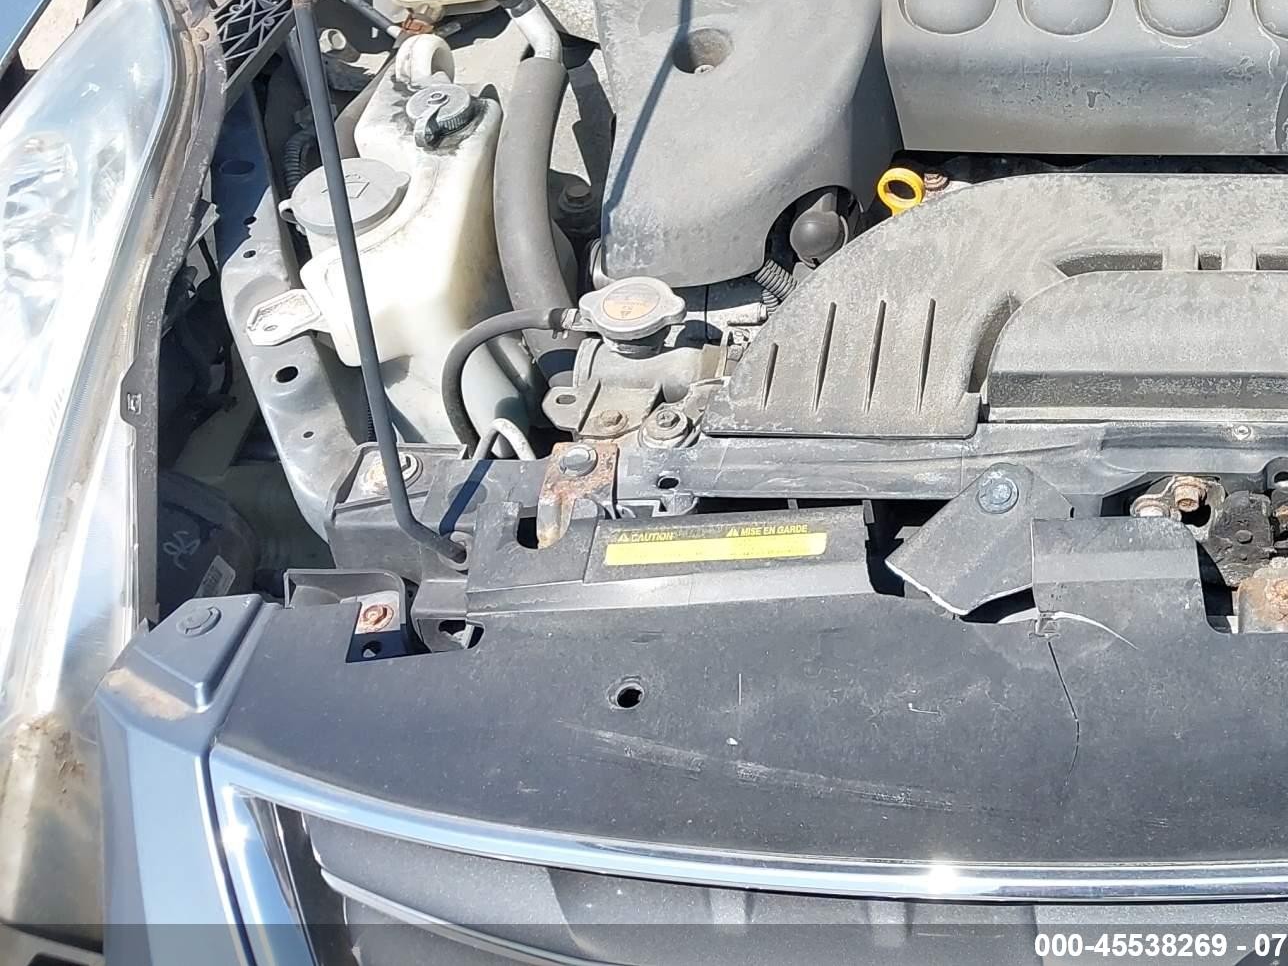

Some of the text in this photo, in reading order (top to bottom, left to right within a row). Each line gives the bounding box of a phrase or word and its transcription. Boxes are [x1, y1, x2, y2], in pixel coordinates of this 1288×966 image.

[630, 531, 674, 542] CAUTION
[740, 524, 808, 537] MISE EN GARDE
